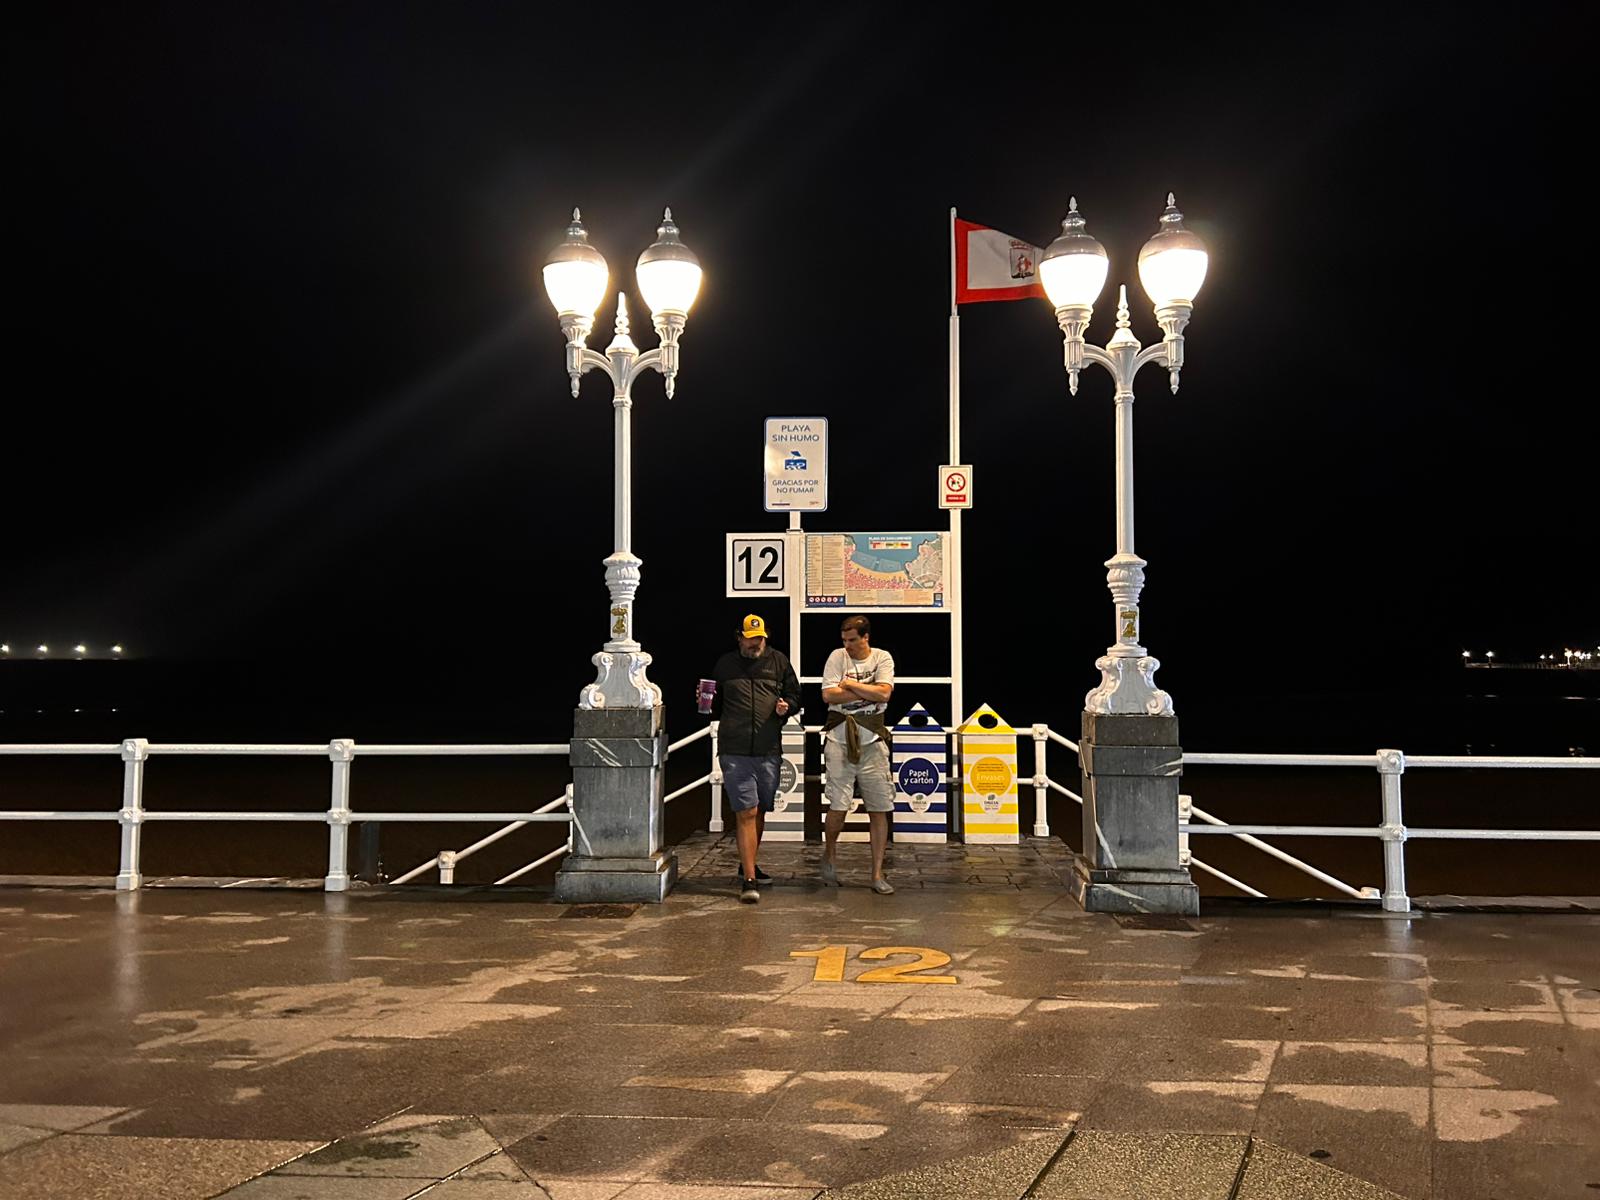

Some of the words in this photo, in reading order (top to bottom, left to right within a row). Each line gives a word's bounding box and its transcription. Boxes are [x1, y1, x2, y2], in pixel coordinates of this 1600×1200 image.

[772, 434, 788, 442] SIN
[790, 434, 820, 442] HUMO
[738, 546, 779, 584] 12
[909, 769, 929, 778] Papel
[903, 777, 909, 785] y
[910, 776, 934, 784] cartón
[789, 945, 958, 984] 12
